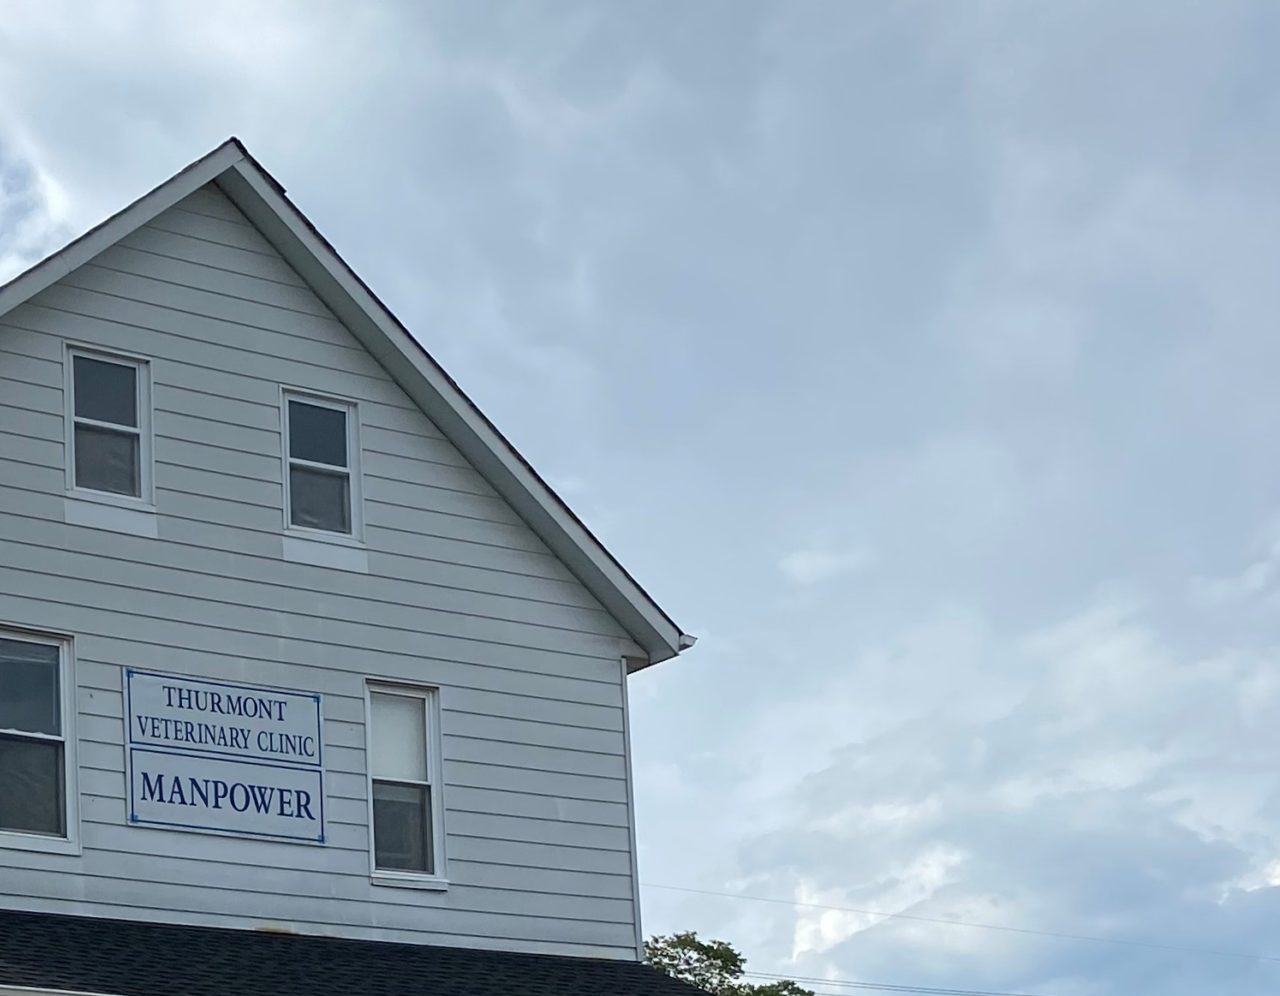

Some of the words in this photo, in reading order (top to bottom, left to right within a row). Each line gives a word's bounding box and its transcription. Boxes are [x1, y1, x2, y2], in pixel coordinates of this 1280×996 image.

[162, 685, 287, 722] THURMONT
[136, 715, 251, 750] VETERINARY
[257, 730, 315, 757] CLINIC
[140, 771, 316, 821] MANPOWER
